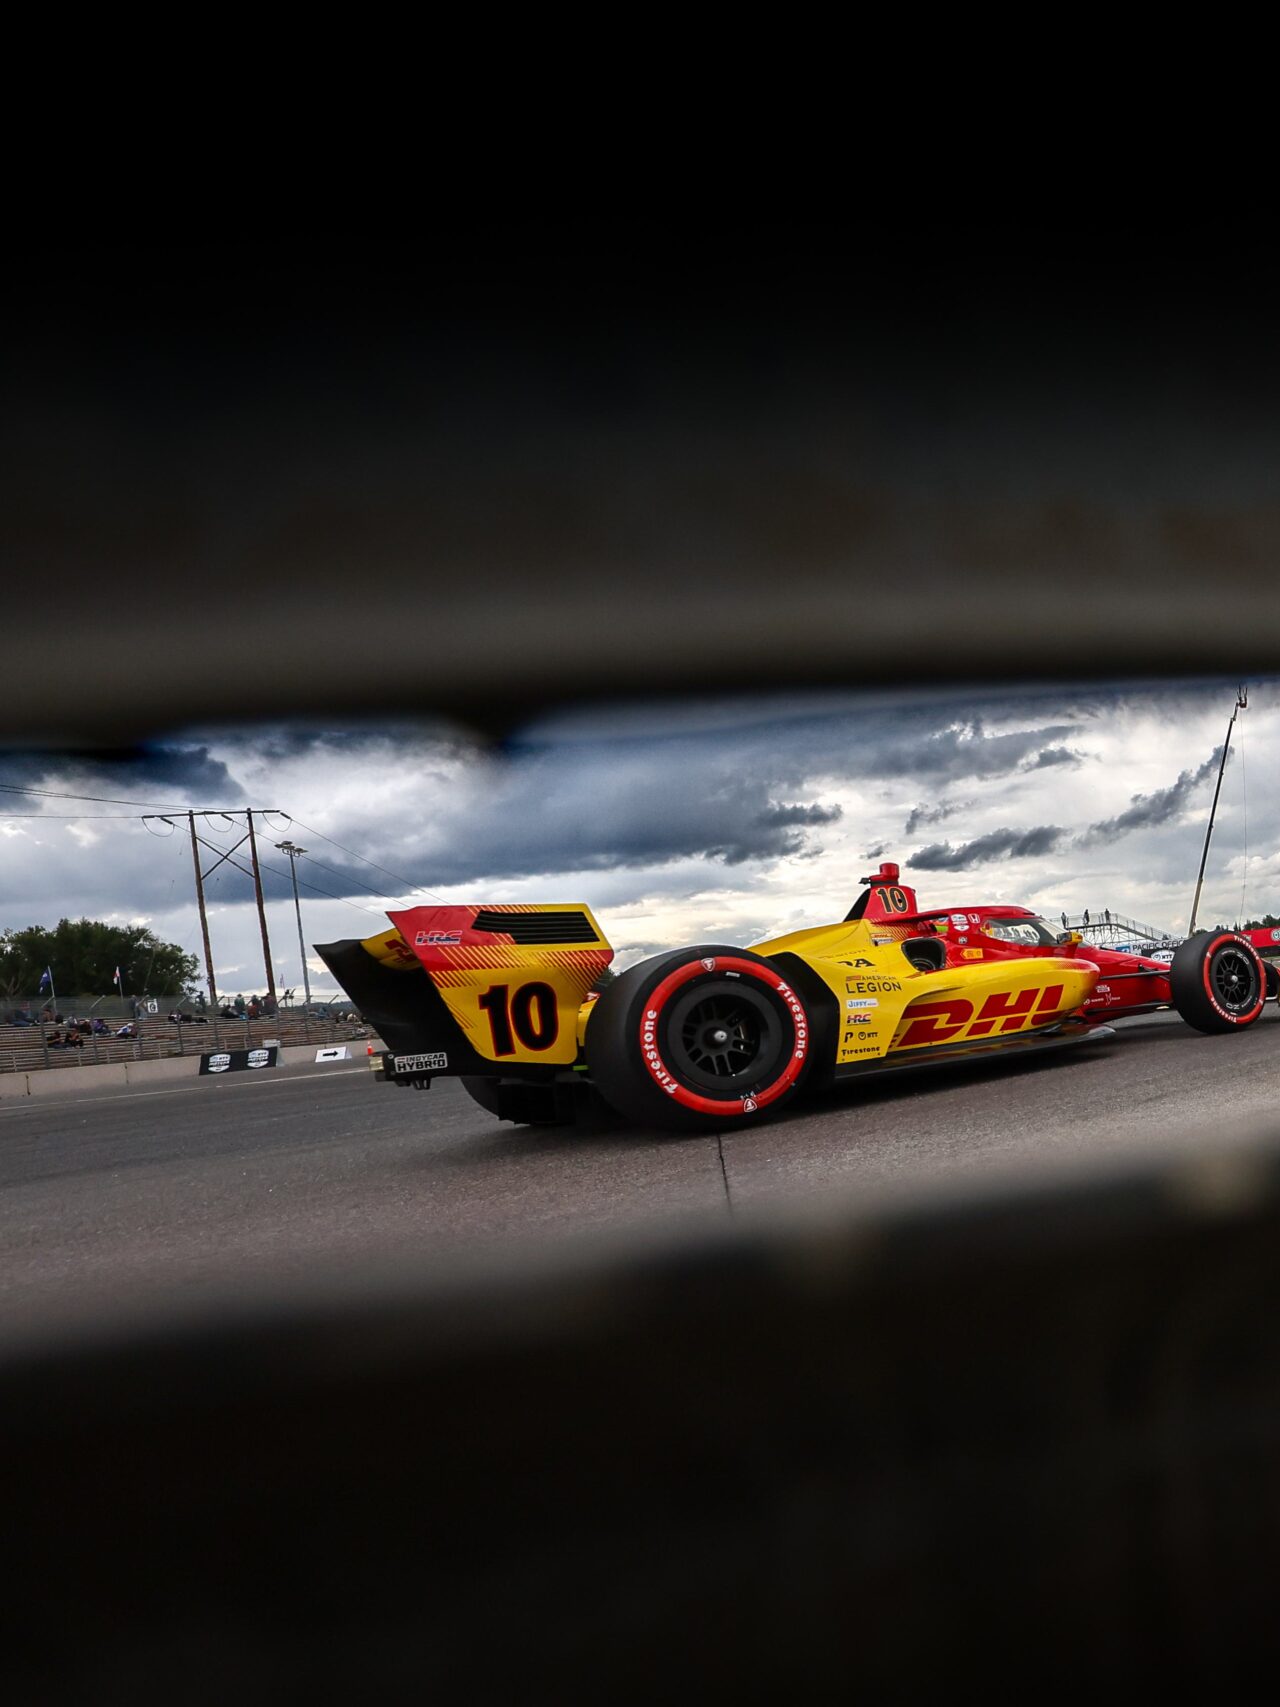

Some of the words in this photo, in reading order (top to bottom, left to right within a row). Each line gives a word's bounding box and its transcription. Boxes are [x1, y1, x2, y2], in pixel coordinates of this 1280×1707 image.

[876, 887, 908, 913] 10
[415, 930, 462, 945] HRC
[1132, 942, 1160, 951] PACIFIC
[846, 981, 902, 994] LEGION
[478, 981, 560, 1057] 10
[777, 982, 807, 1058] Firestone
[847, 1014, 872, 1024] HRC
[896, 984, 1070, 1047] DHL
[406, 1053, 445, 1063] INDYCAR
[644, 1010, 679, 1094] Firestone
[841, 1046, 880, 1056] Firestone
